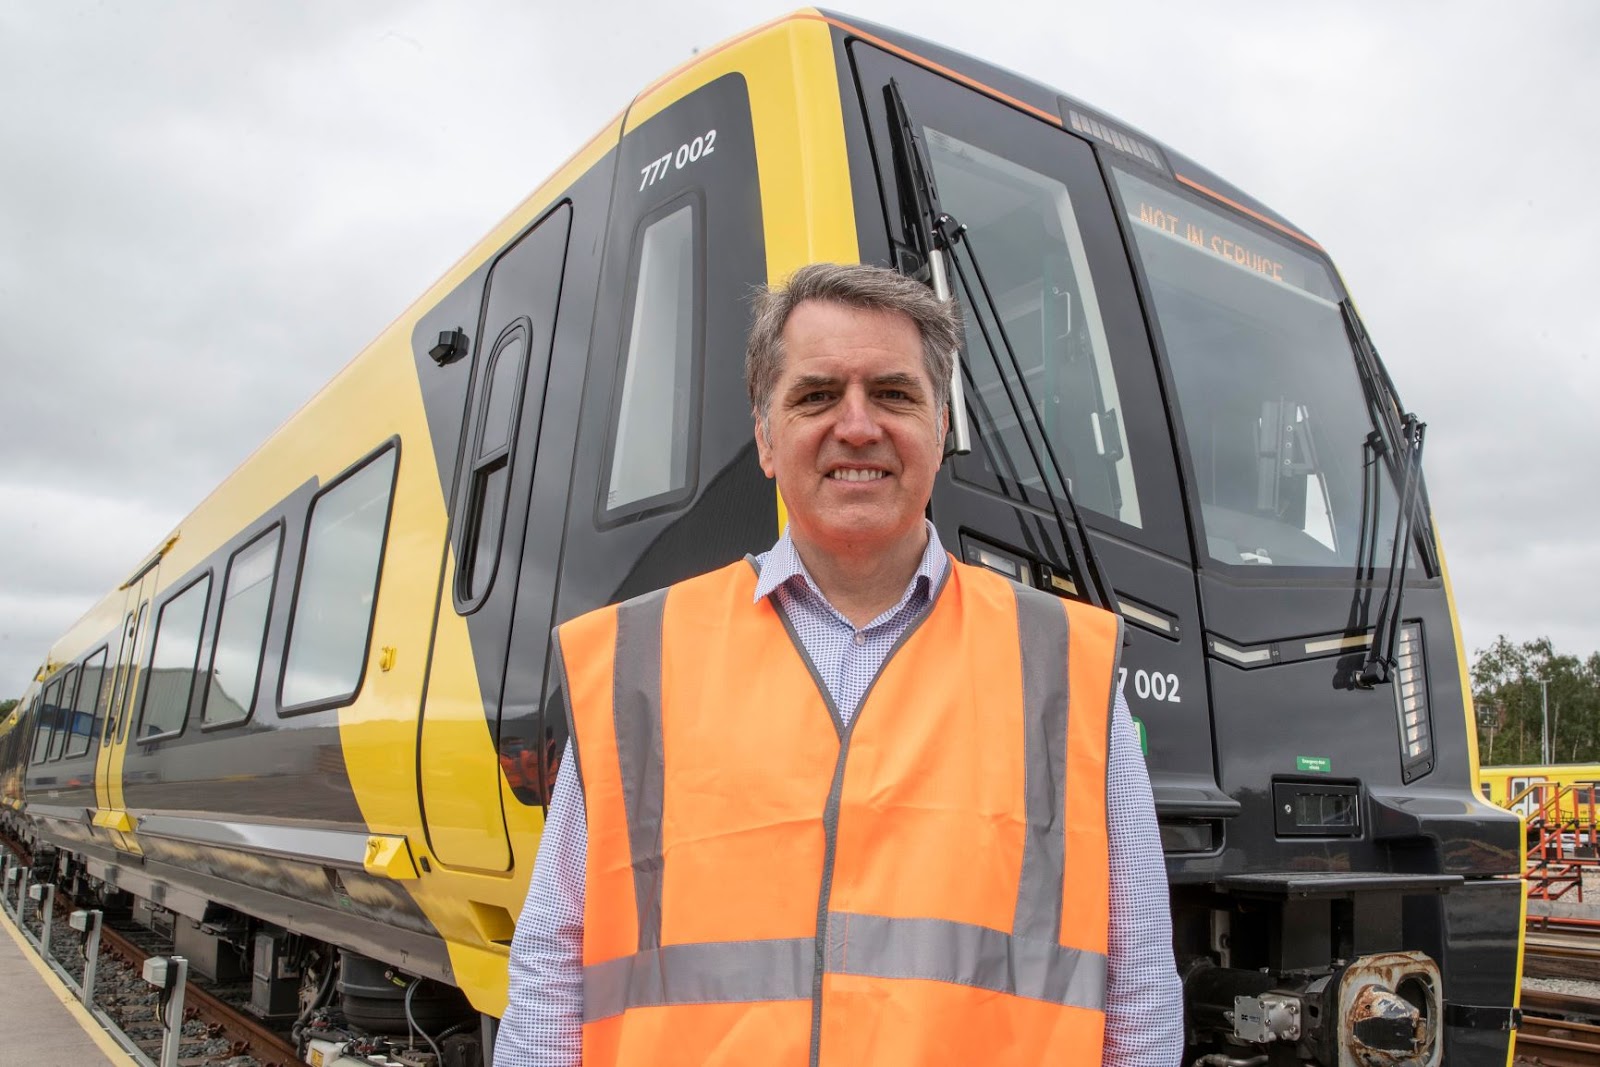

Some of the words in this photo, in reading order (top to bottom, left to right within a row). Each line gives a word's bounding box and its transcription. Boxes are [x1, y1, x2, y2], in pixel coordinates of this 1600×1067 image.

[639, 151, 673, 192] 777
[675, 129, 717, 169] 002
[1140, 202, 1178, 235] NOT
[1186, 223, 1204, 248] IN
[1211, 235, 1282, 281] SERVICE
[1134, 669, 1181, 703] 002
